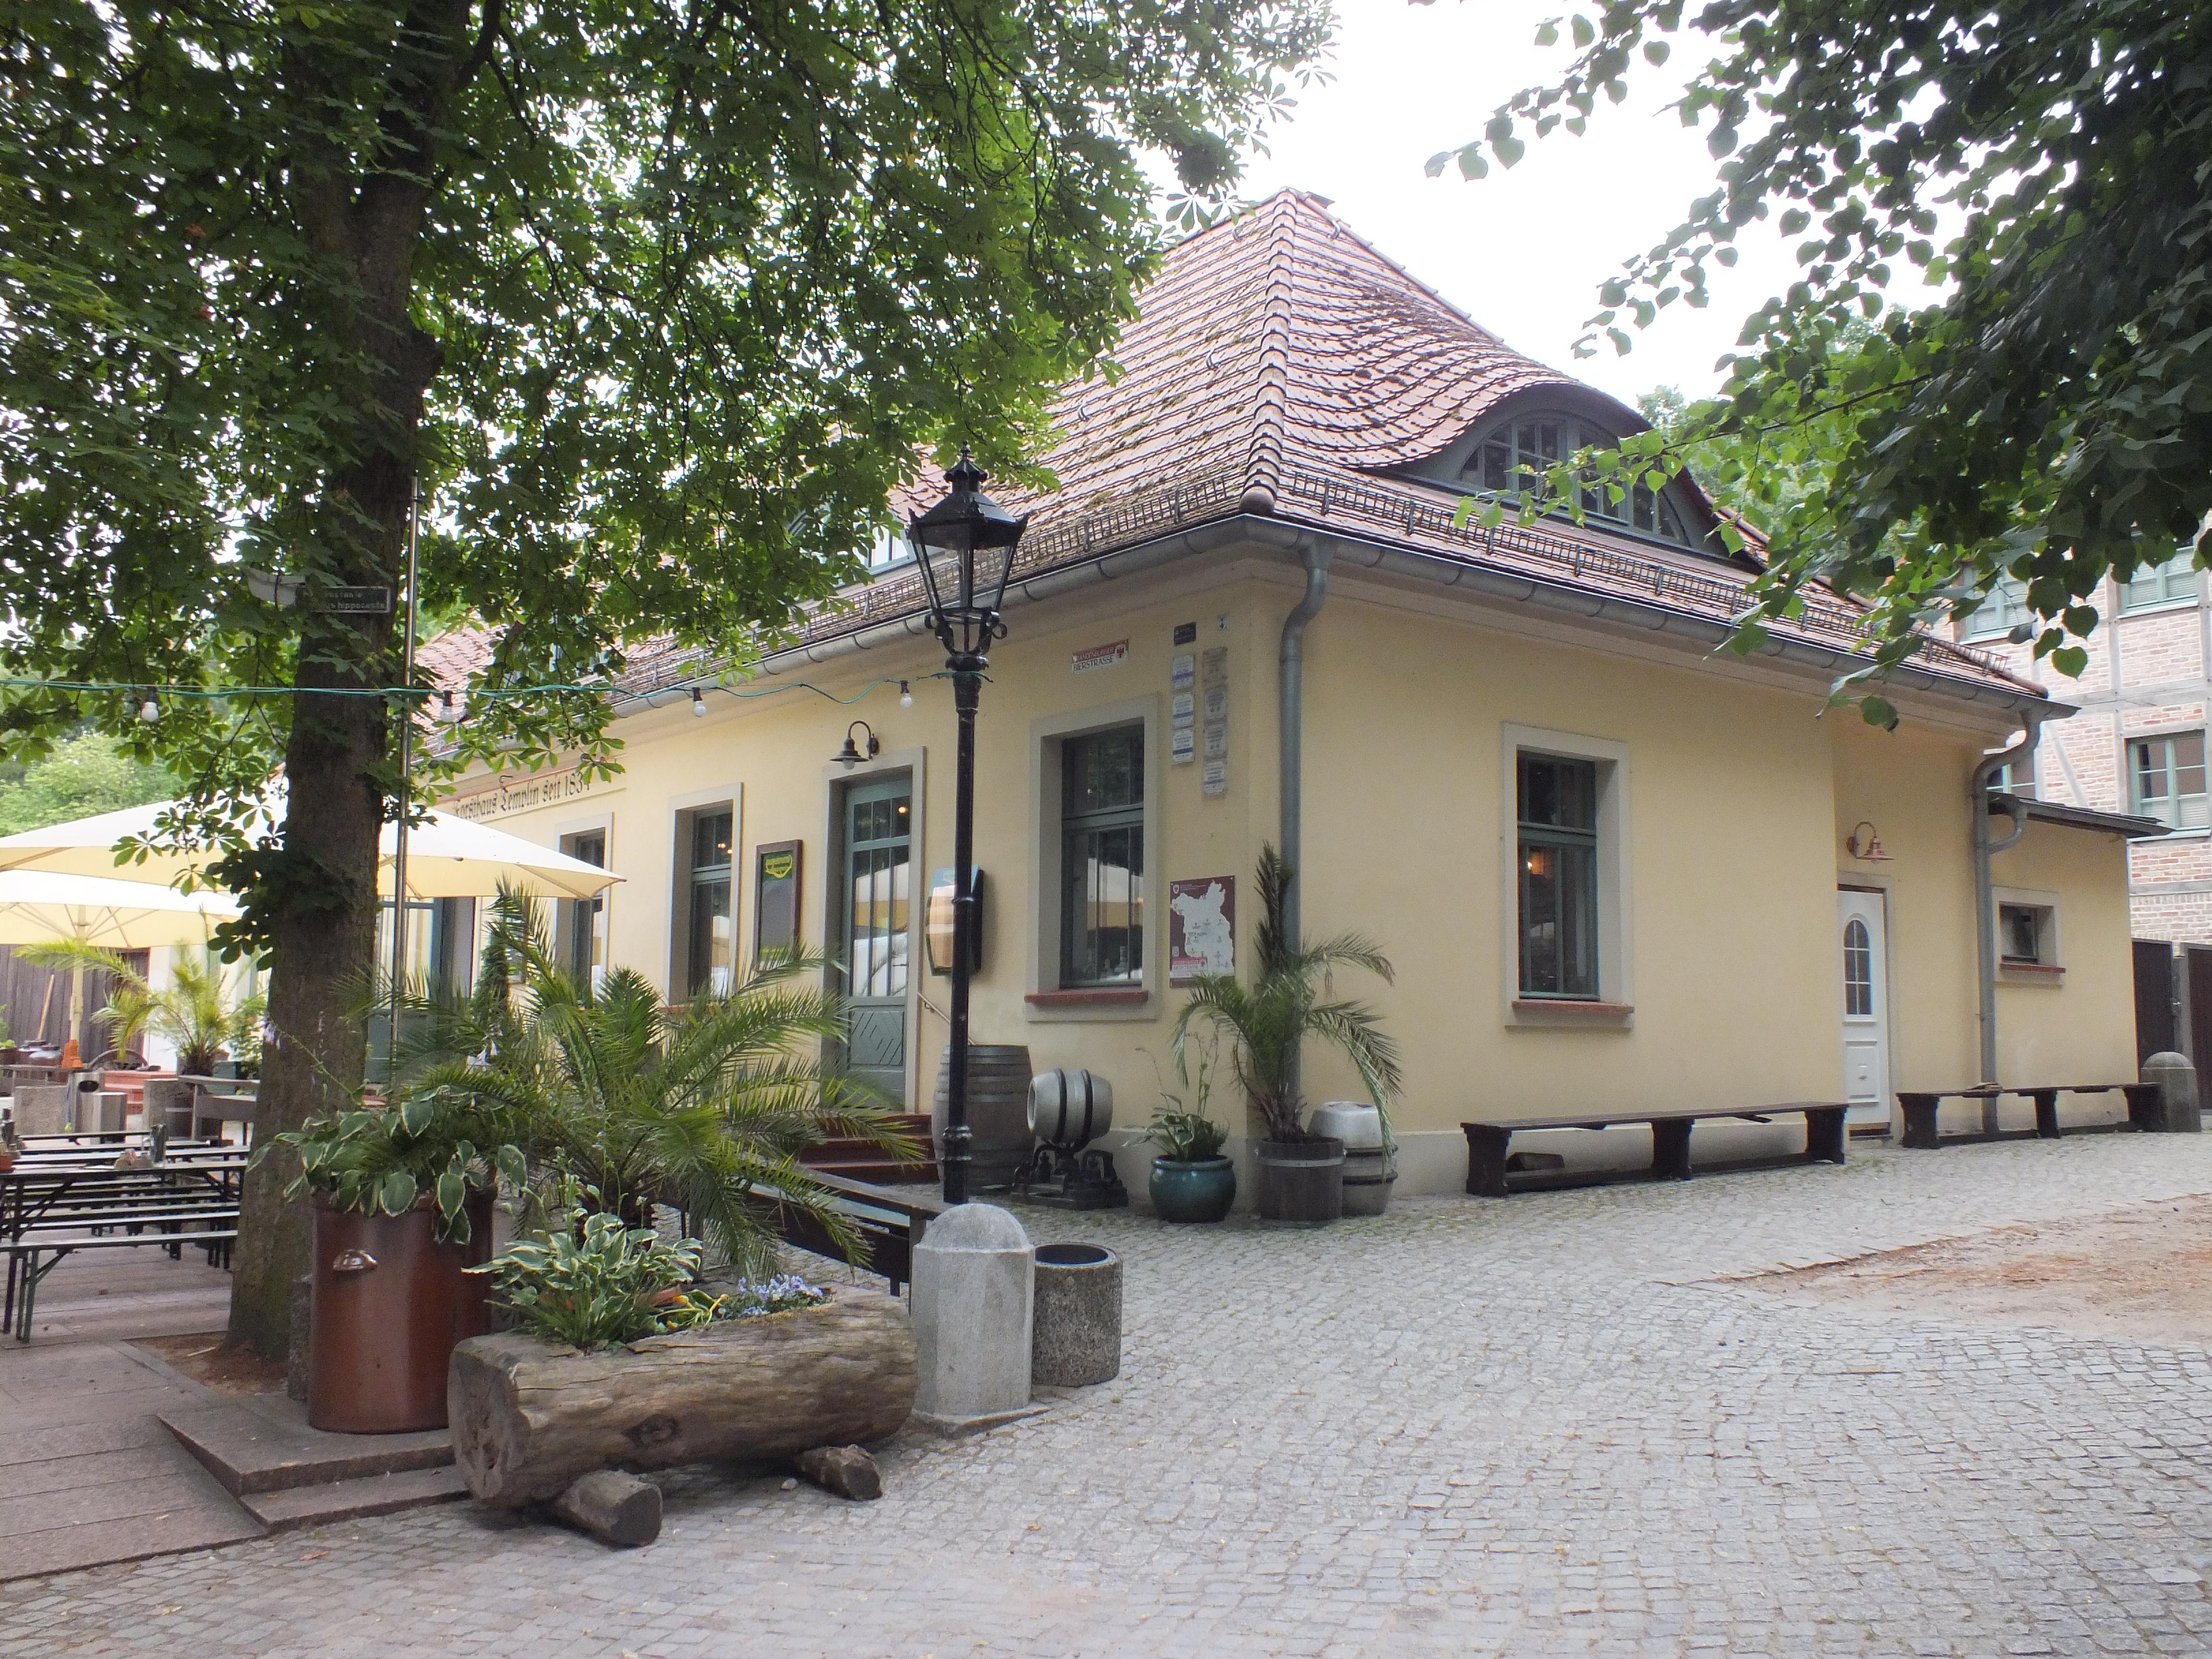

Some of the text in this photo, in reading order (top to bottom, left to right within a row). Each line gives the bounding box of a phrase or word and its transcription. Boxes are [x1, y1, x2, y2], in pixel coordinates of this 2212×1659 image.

[1073, 654, 1114, 671] BIERSTRASSE
[499, 775, 539, 811] Templin
[542, 775, 561, 802] seit
